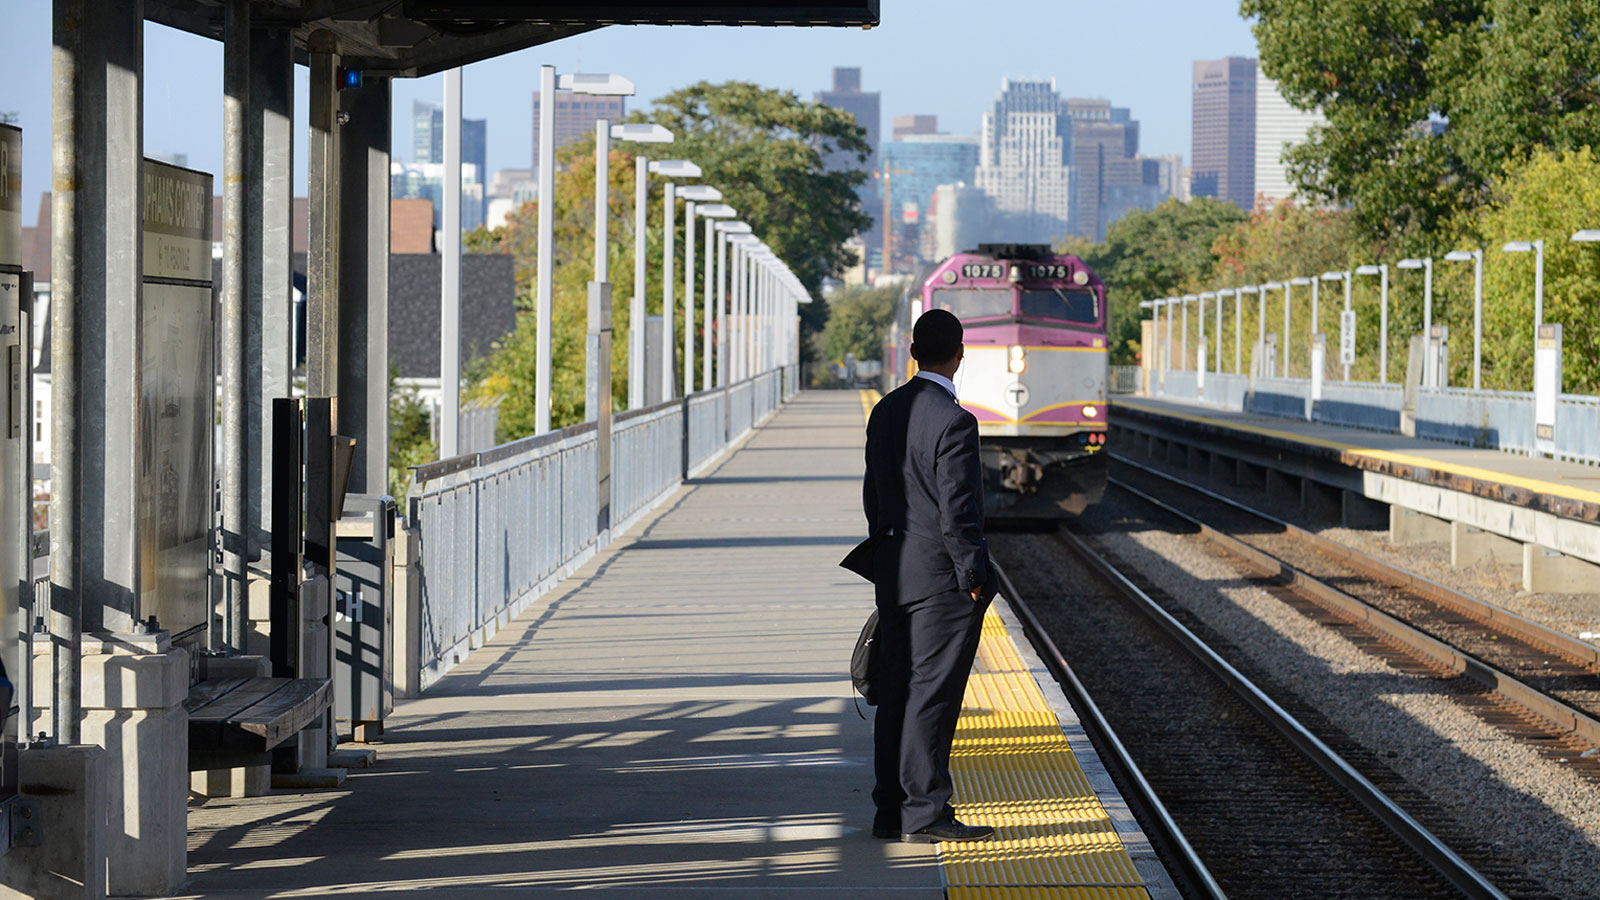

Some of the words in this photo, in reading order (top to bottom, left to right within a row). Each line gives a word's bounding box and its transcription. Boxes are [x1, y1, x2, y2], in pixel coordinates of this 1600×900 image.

[175, 180, 205, 230] CORNER
[964, 265, 1001, 278] 1075
[1031, 265, 1066, 278] 1075
[1009, 389, 1025, 404] T
